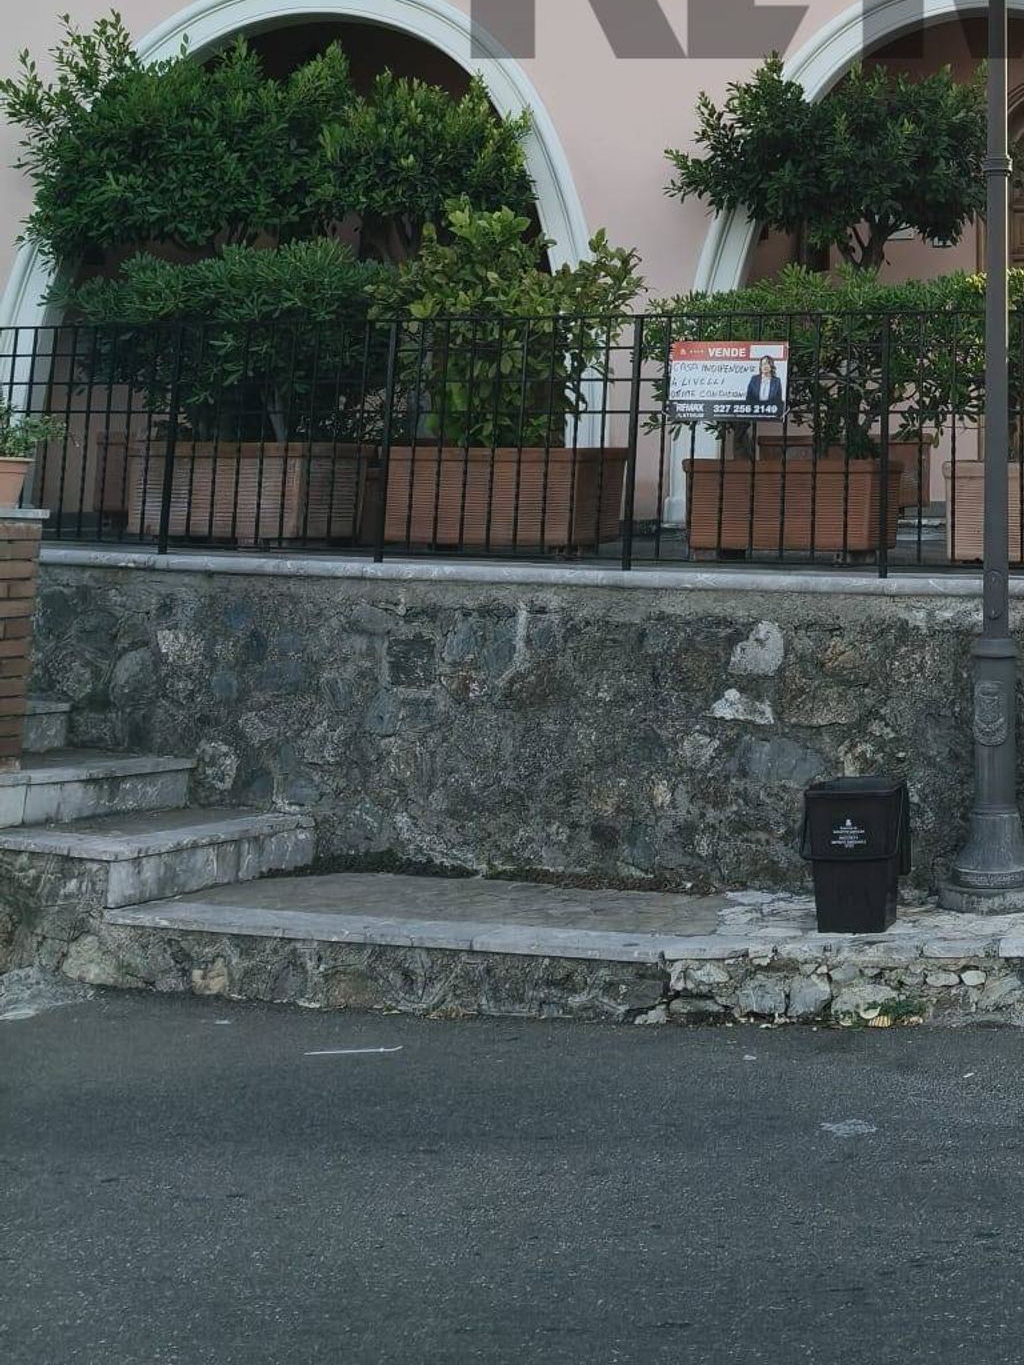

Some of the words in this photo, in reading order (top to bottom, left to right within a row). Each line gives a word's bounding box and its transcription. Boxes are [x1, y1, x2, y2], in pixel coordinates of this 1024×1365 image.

[708, 347, 746, 357] VENDE
[713, 405, 731, 413] 327
[733, 405, 751, 413] 256
[754, 405, 778, 413] 2149
